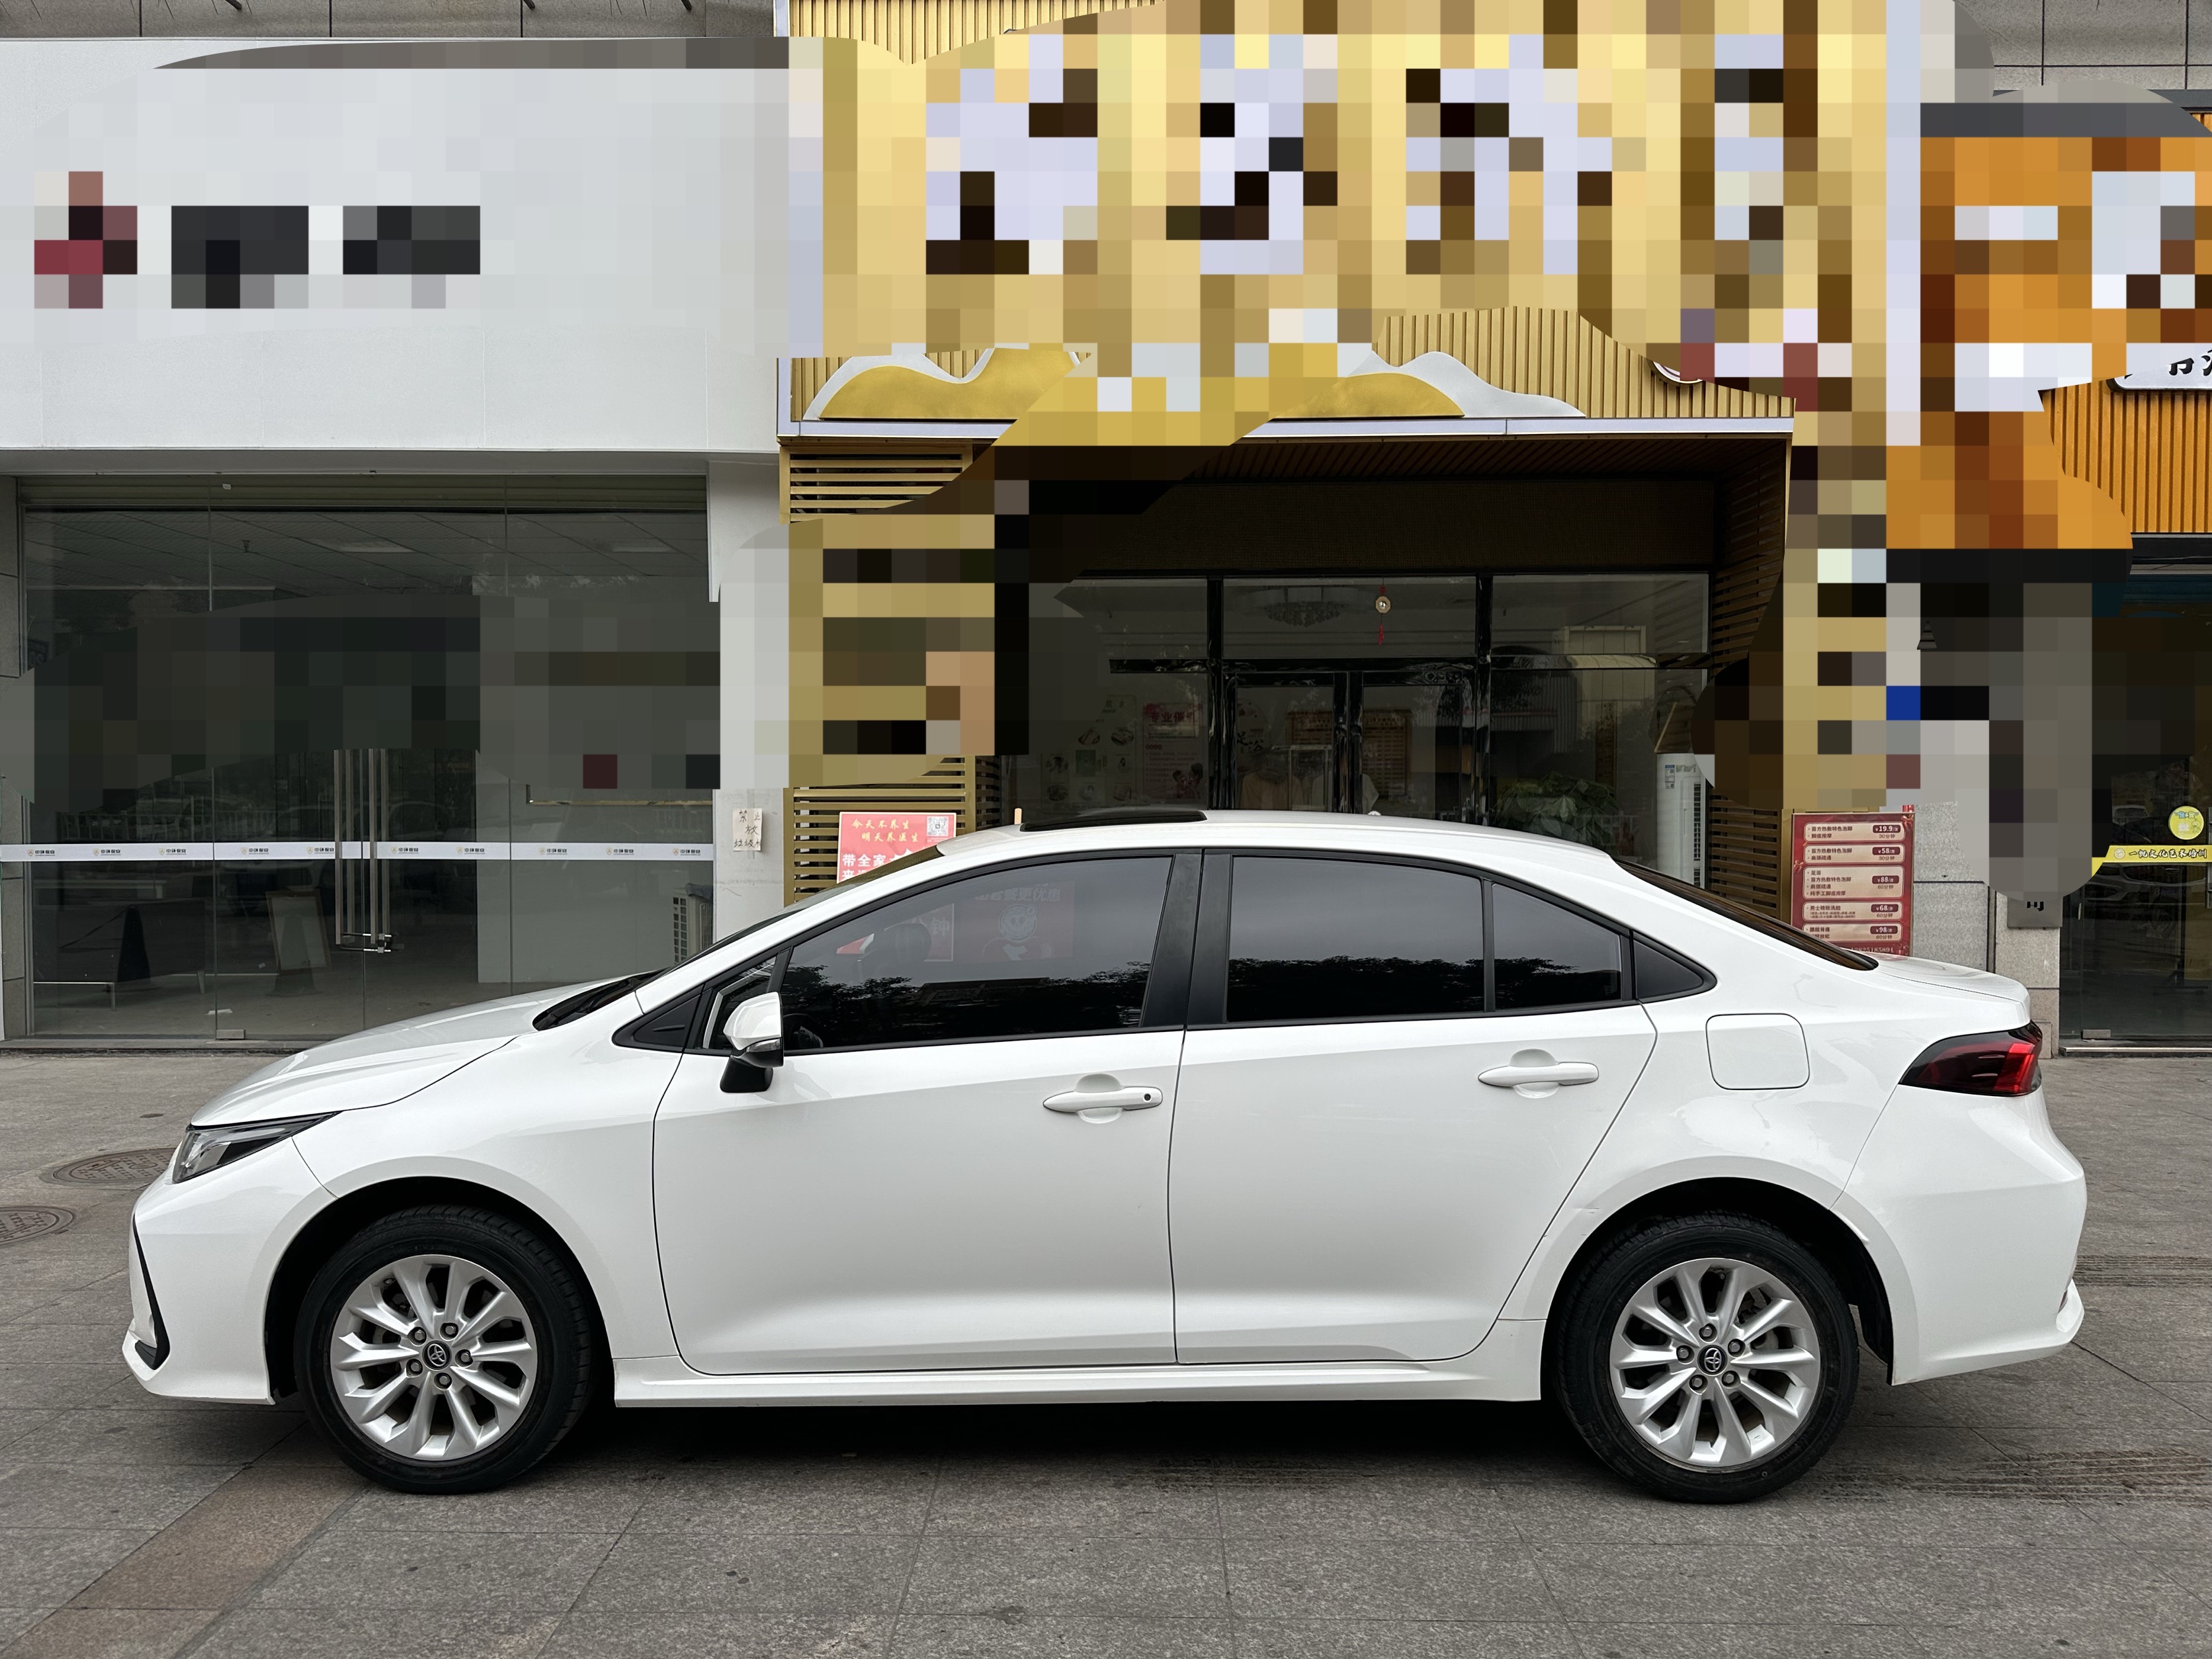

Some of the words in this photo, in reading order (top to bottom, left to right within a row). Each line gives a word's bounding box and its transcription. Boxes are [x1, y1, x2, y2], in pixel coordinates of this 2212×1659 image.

[851, 819, 910, 830] 今天不养生
[745, 825, 759, 835] 放
[861, 832, 919, 842] 明天养医生
[842, 853, 886, 867] 带全家
